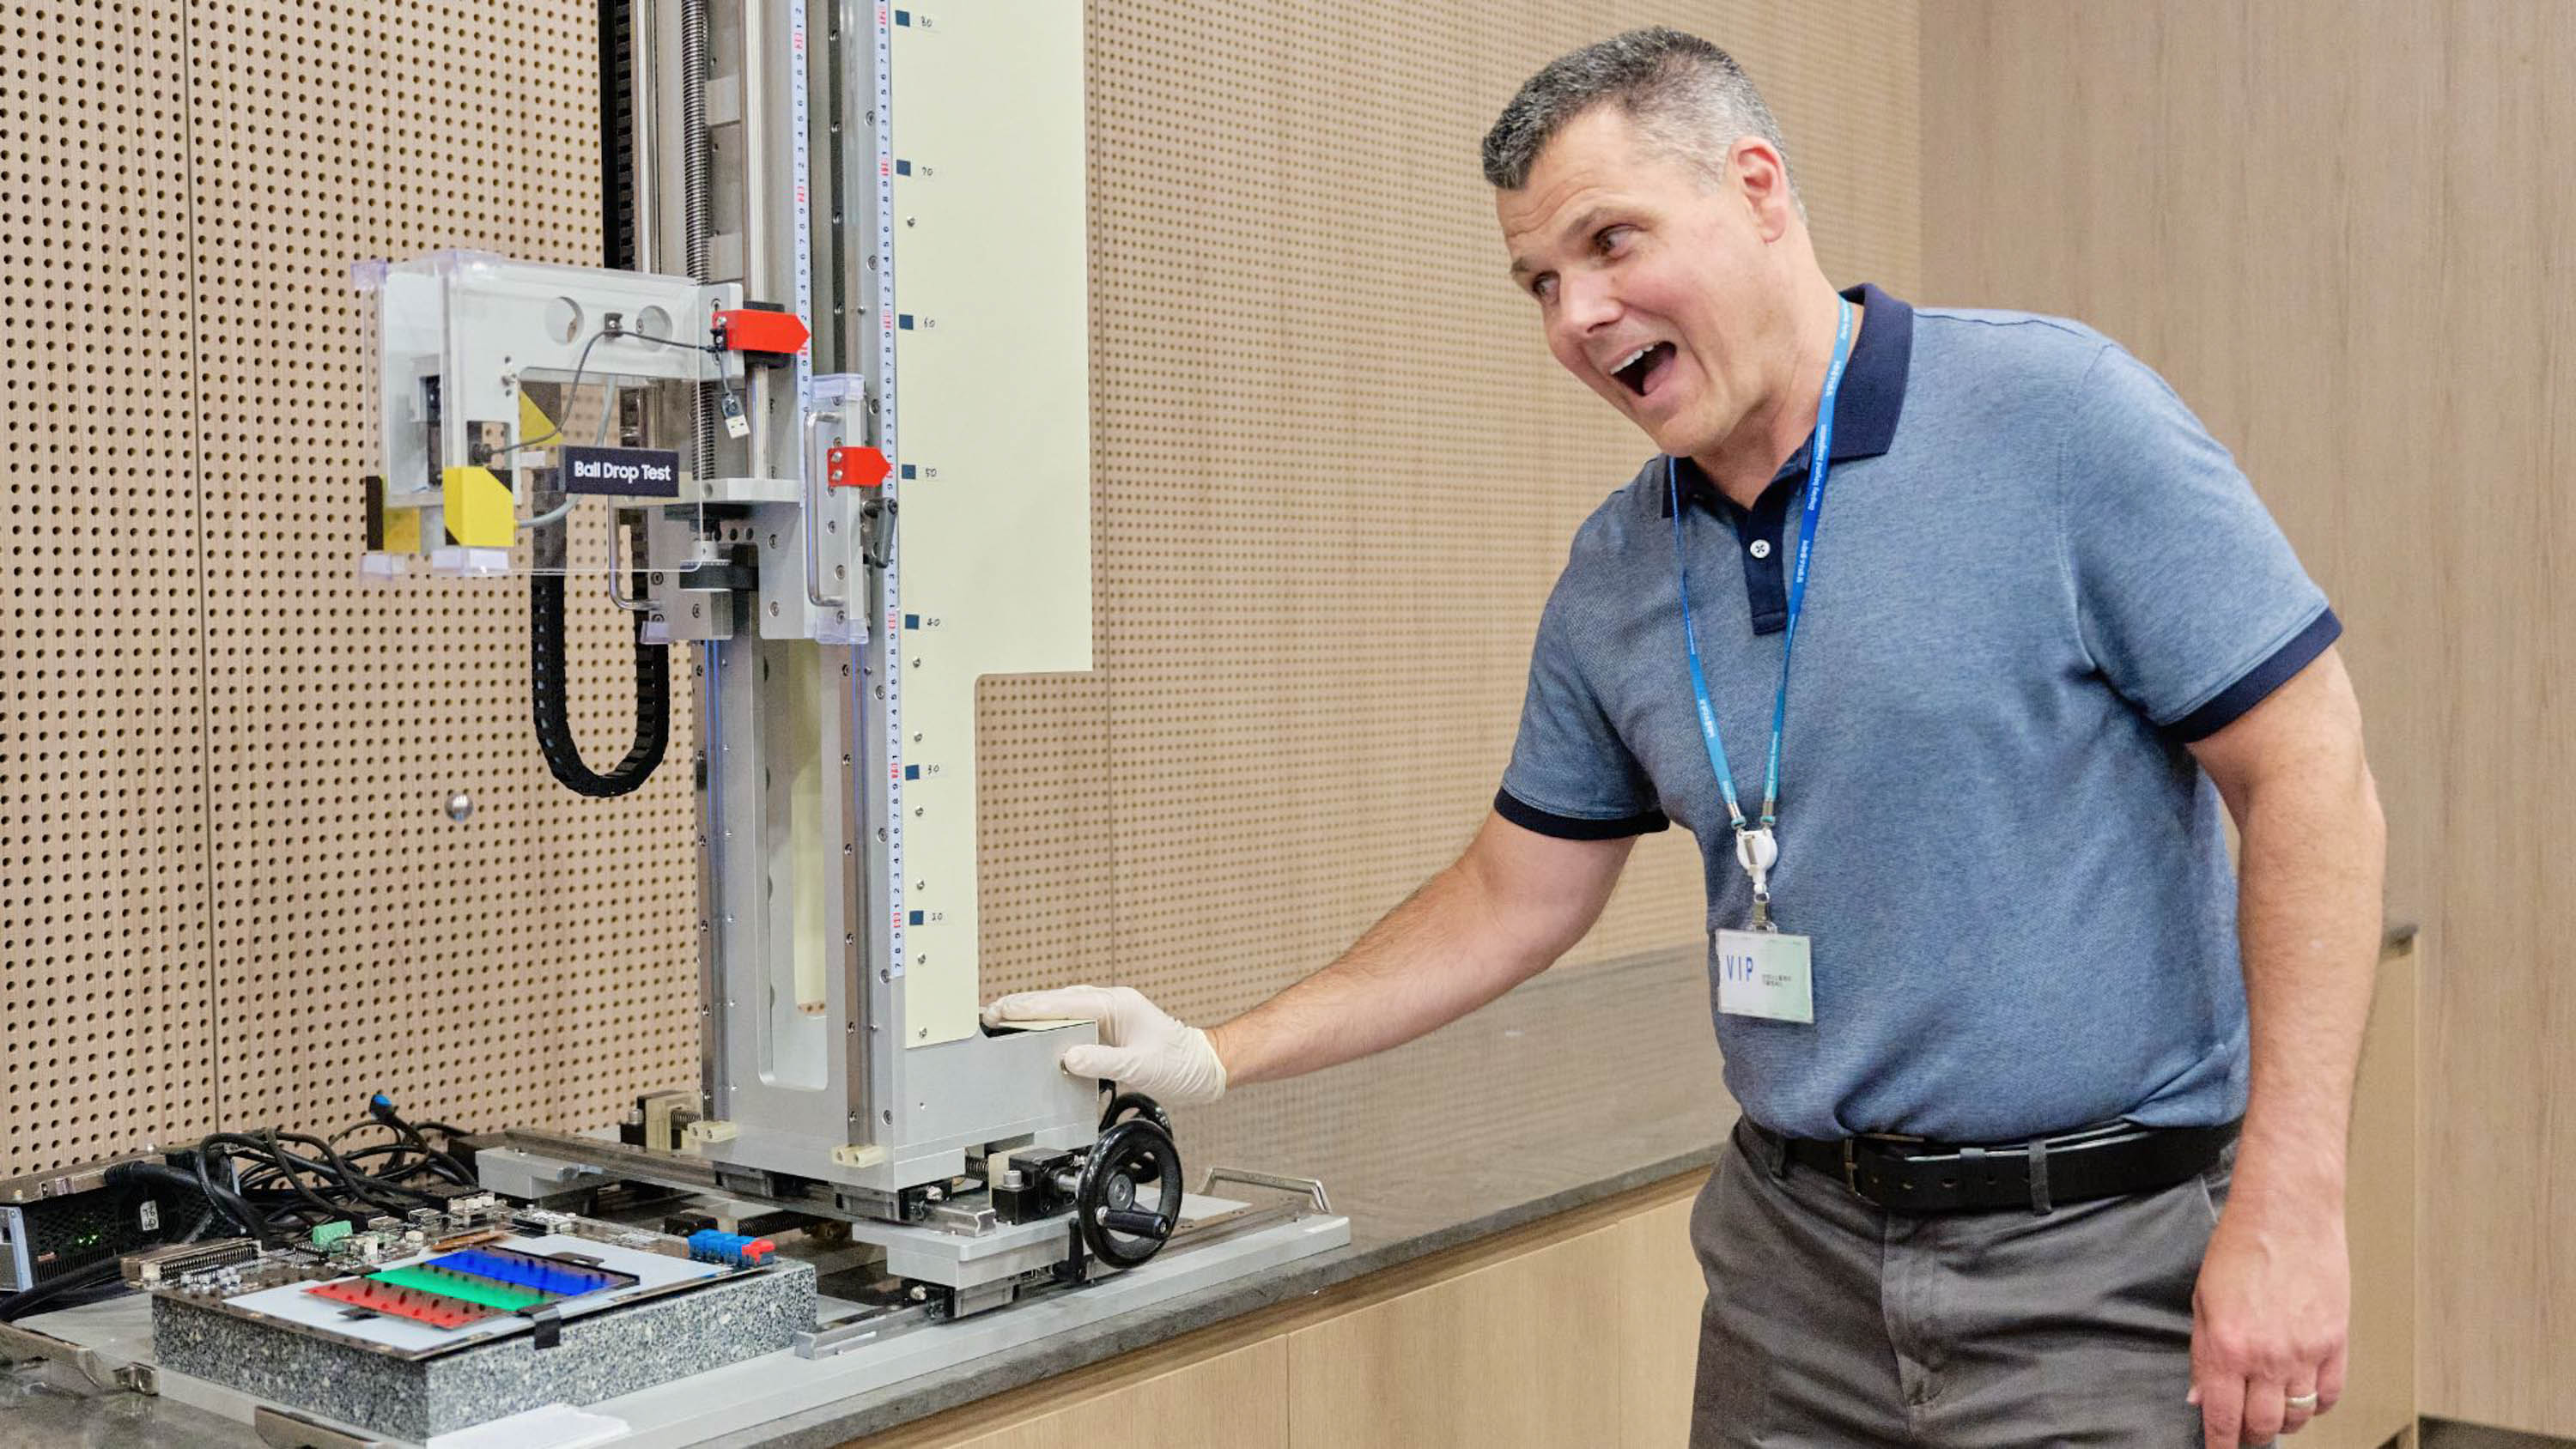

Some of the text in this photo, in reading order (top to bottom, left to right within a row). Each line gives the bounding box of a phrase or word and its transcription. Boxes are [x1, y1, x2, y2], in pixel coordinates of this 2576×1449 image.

[574, 460, 671, 484] Ball Drop Test
[1726, 954, 1754, 982] VIP
